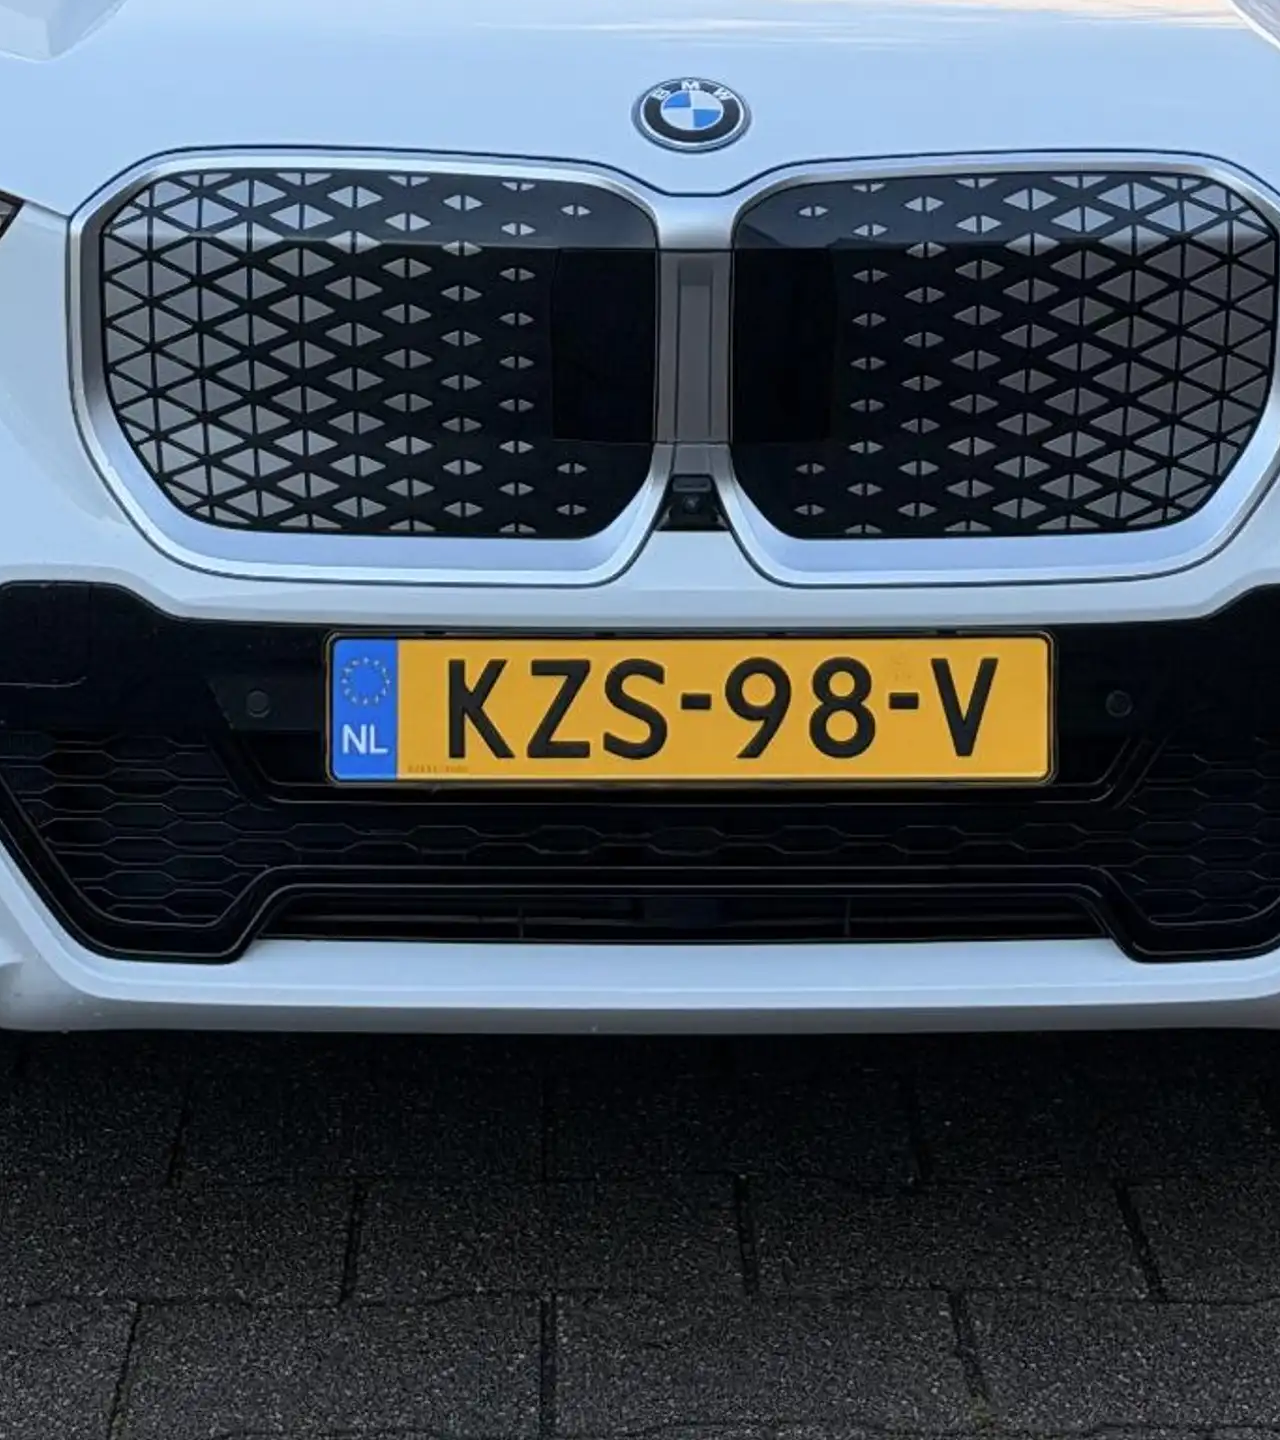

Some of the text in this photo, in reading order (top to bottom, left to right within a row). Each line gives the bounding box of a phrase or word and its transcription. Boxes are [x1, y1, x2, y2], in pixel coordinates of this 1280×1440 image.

[651, 79, 733, 101] BMW
[448, 656, 1000, 761] KZS-98-V
[342, 724, 389, 755] NL
